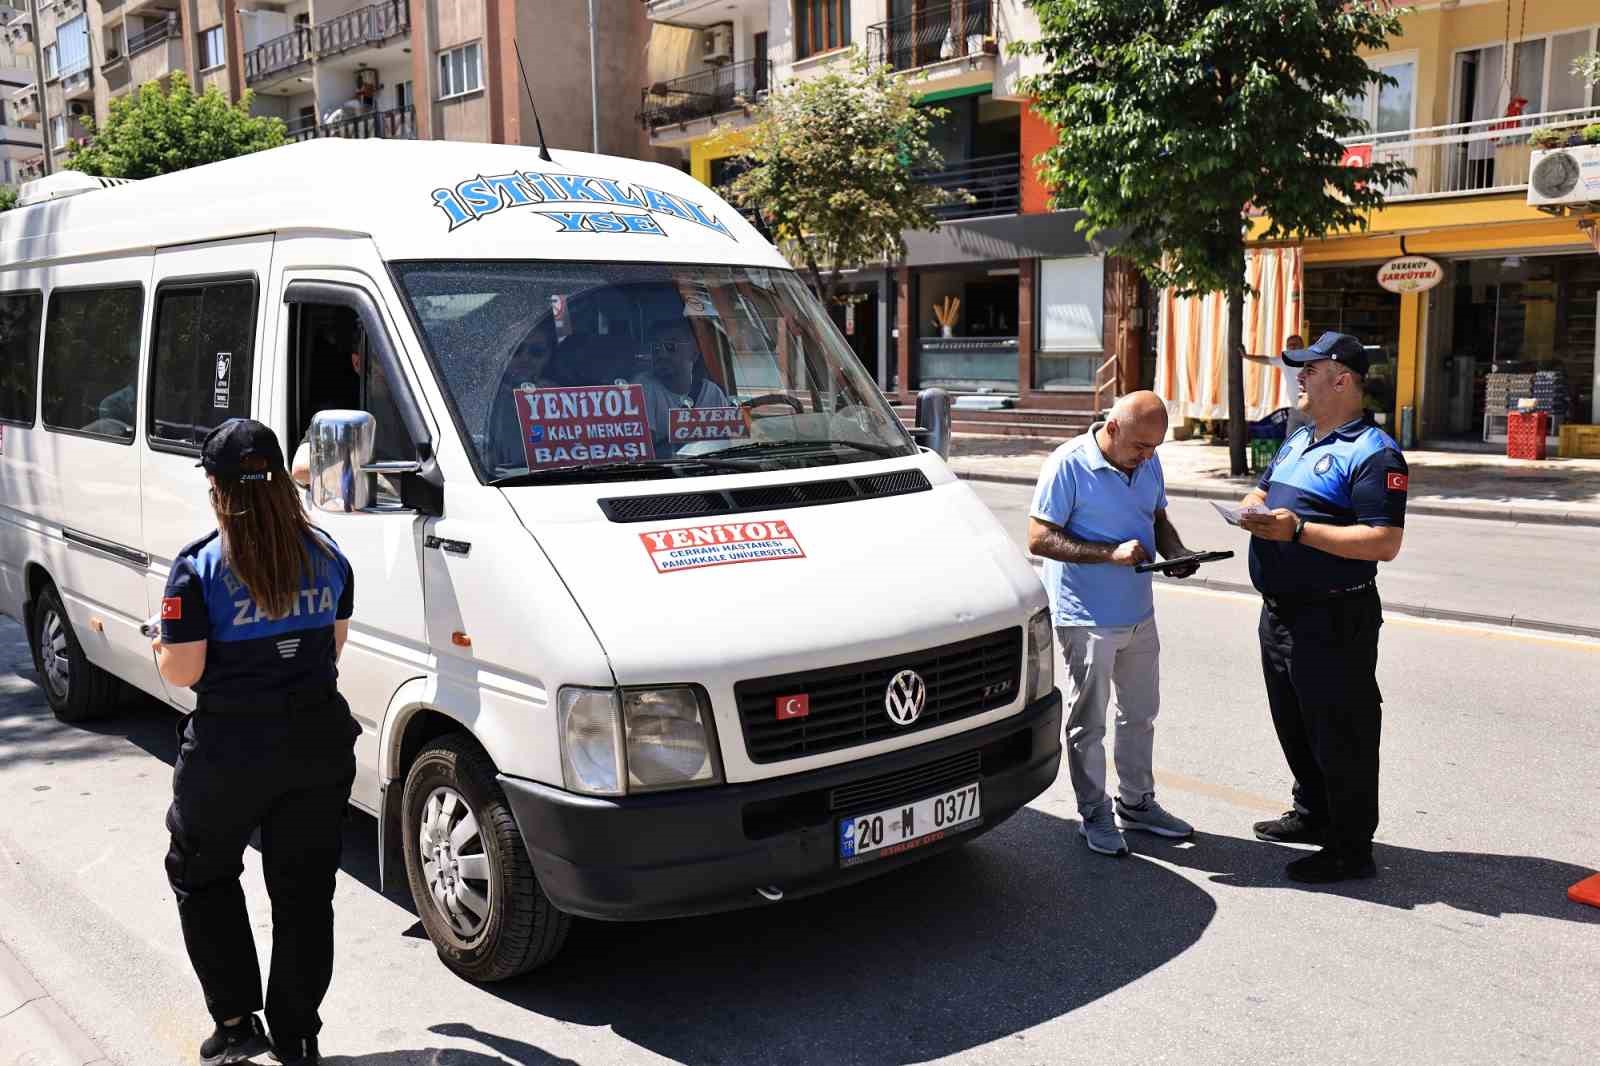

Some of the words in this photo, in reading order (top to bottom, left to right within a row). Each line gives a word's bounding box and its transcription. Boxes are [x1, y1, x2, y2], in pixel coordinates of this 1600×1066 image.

[530, 211, 668, 237] YSE
[547, 427, 582, 441] KALP
[674, 426, 745, 439] GARAJ
[535, 442, 647, 464] BAĞBAŞI
[661, 554, 727, 569] PAMUKKALE
[233, 586, 334, 625] ZAITA
[858, 815, 884, 850] 20
[902, 806, 914, 838] M
[934, 786, 977, 827] 0377
